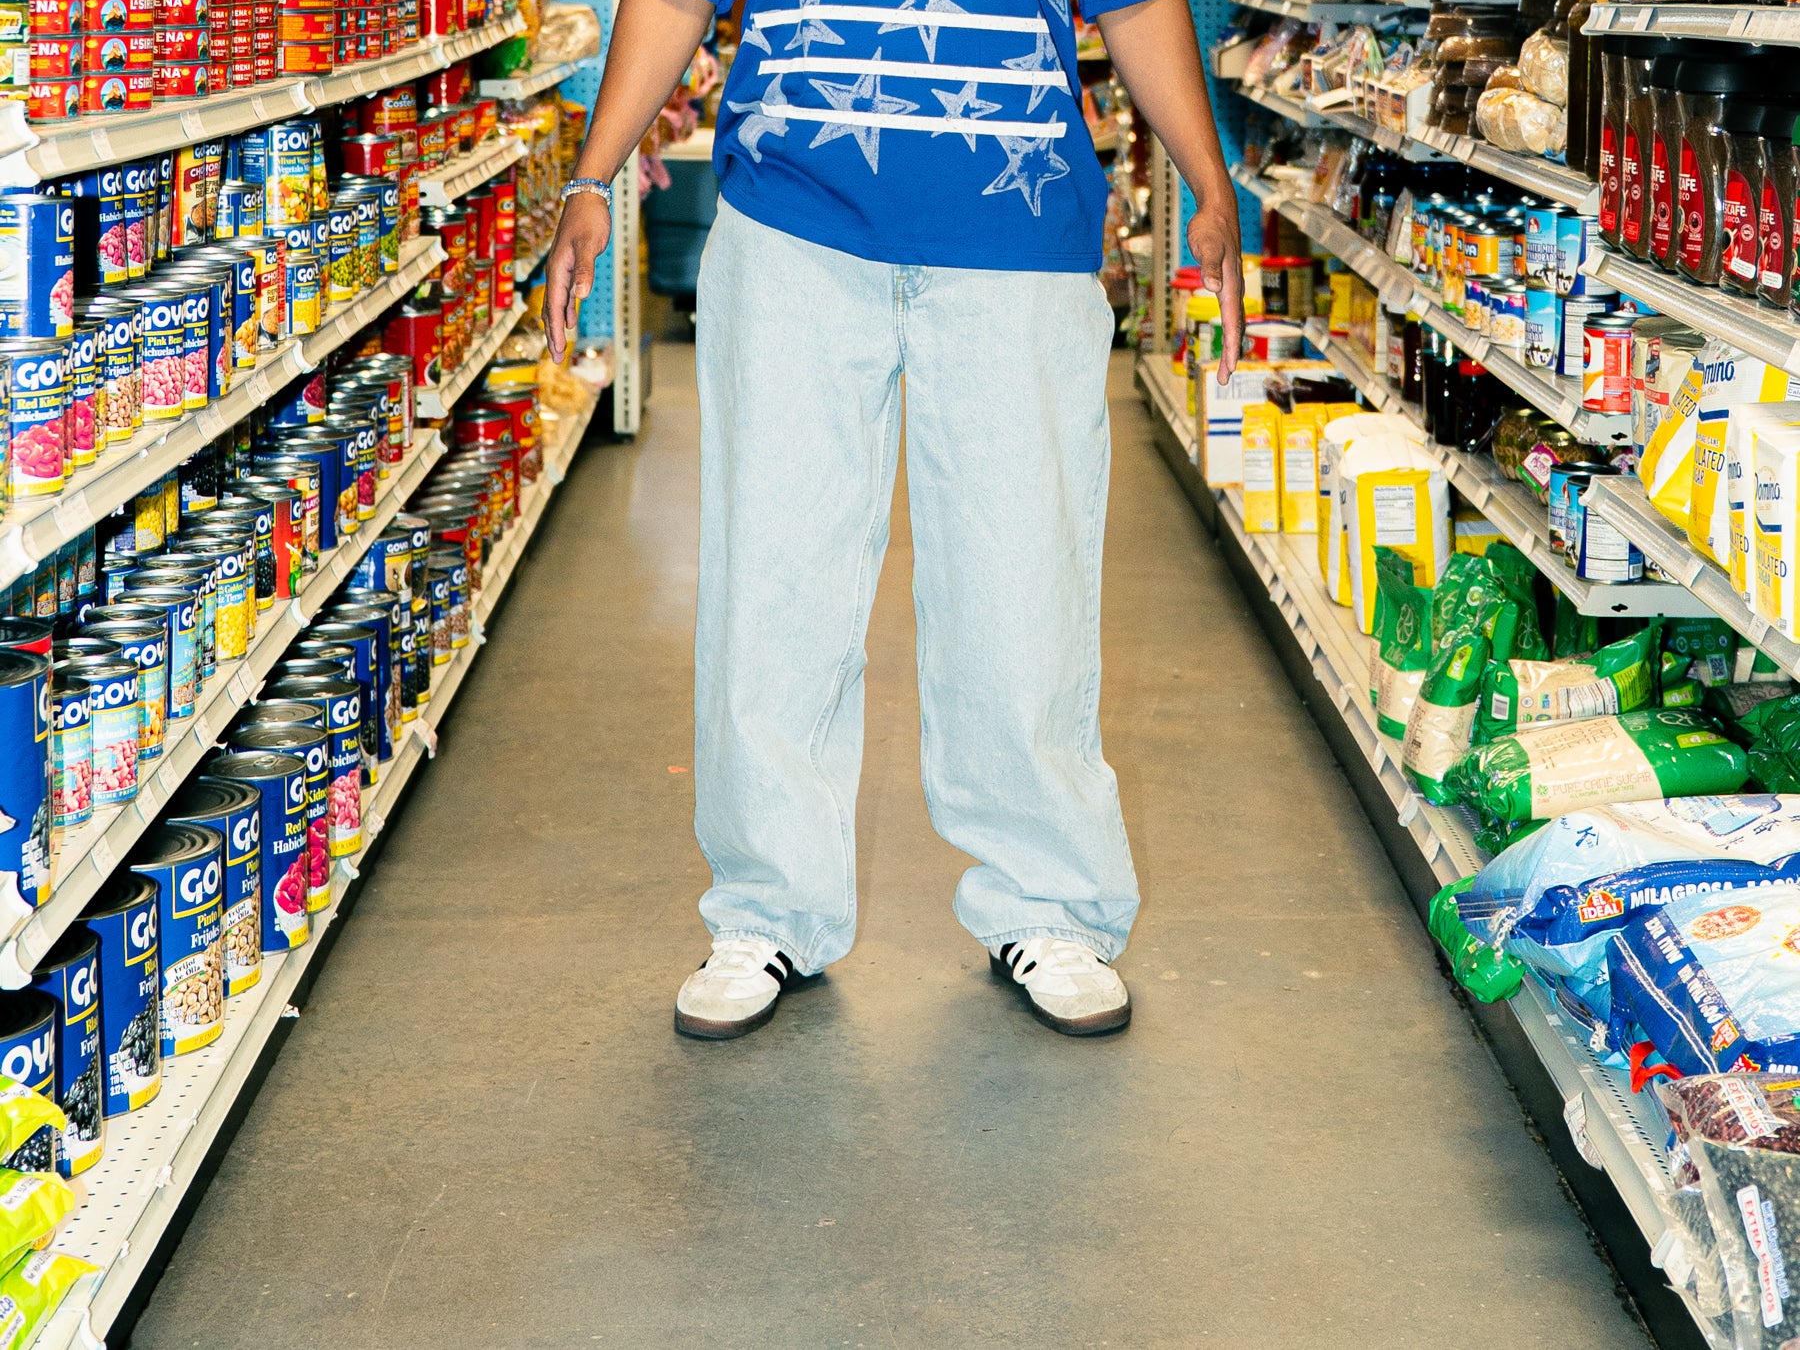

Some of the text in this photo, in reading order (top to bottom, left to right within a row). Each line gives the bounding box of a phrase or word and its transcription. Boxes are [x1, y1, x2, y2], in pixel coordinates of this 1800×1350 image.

[17, 398, 38, 410] Red
[386, 538, 409, 553] GOYA
[1592, 893, 1606, 907] EL
[197, 911, 218, 929] Pinto
[1582, 903, 1620, 921] IDEAL
[174, 958, 196, 974] Frijol
[1743, 1199, 1762, 1250] EXTRA
